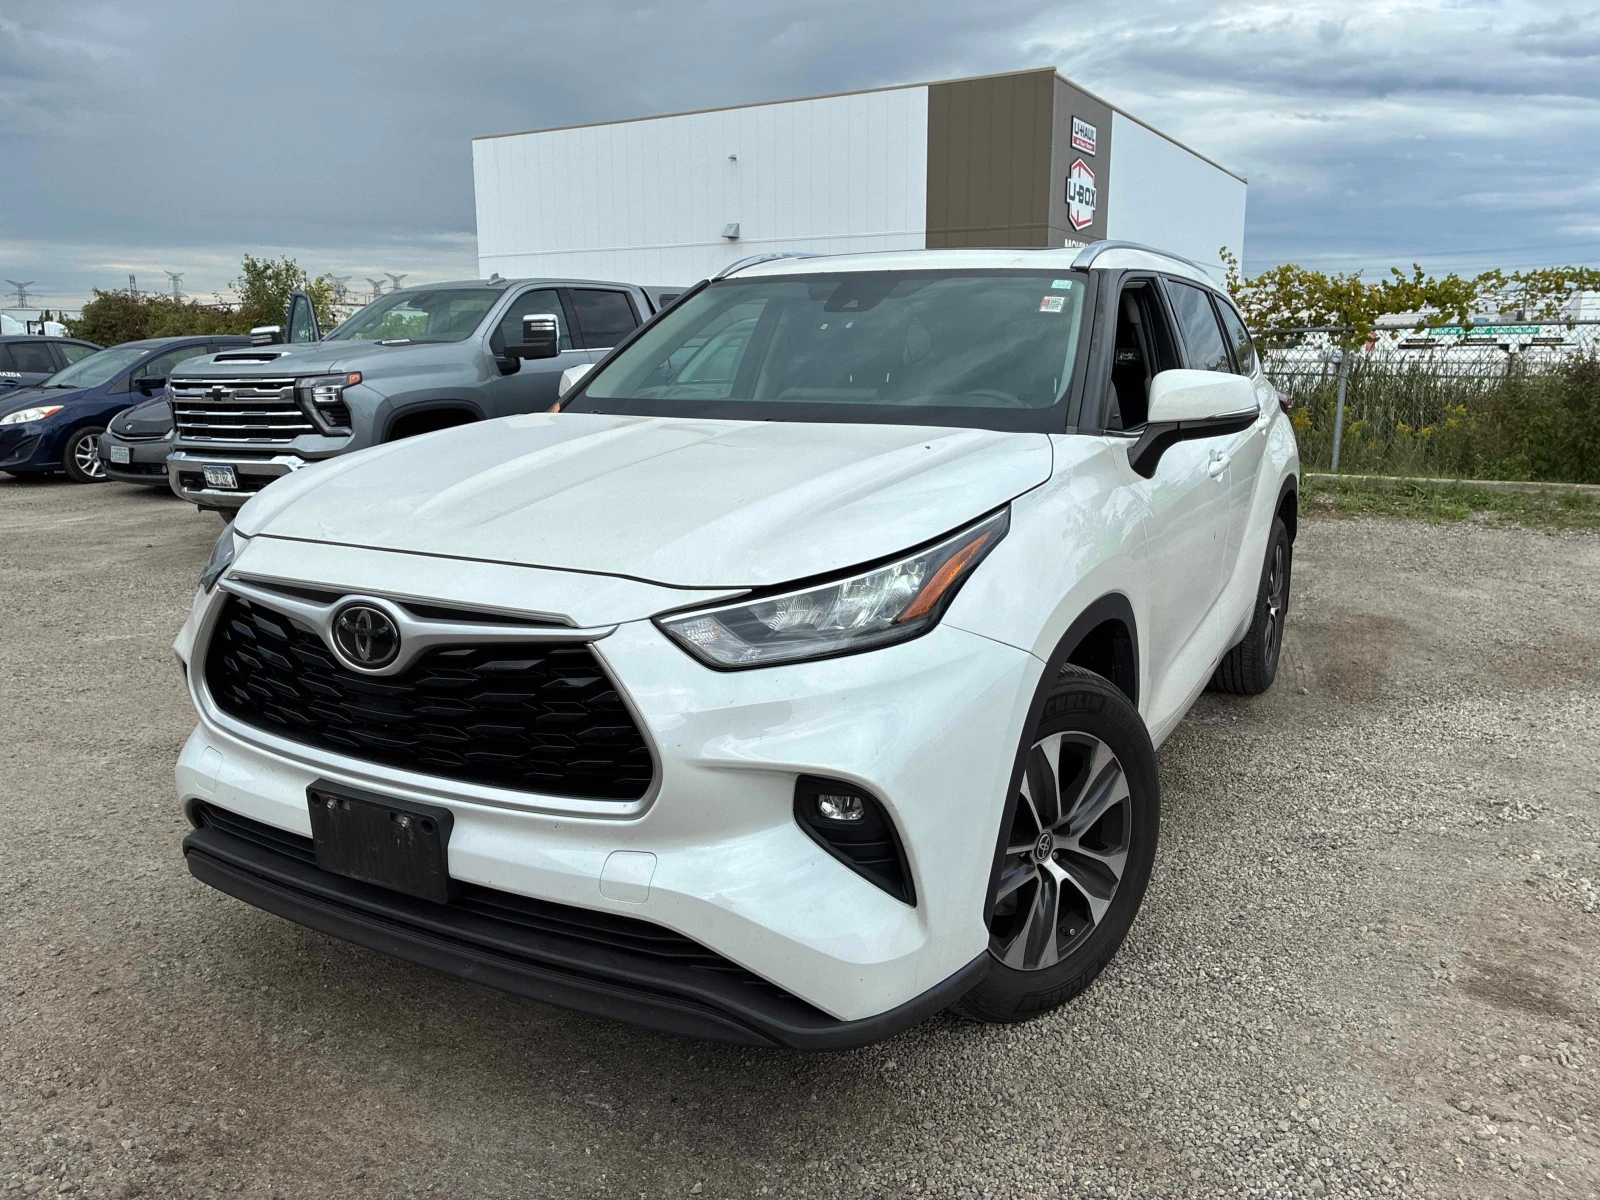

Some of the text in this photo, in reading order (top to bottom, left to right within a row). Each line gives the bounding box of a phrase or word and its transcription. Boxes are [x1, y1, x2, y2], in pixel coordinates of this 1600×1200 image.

[1074, 121, 1095, 143] U-HAUL
[1068, 180, 1096, 209] U-BOX
[1044, 694, 1103, 717] CHELIN
